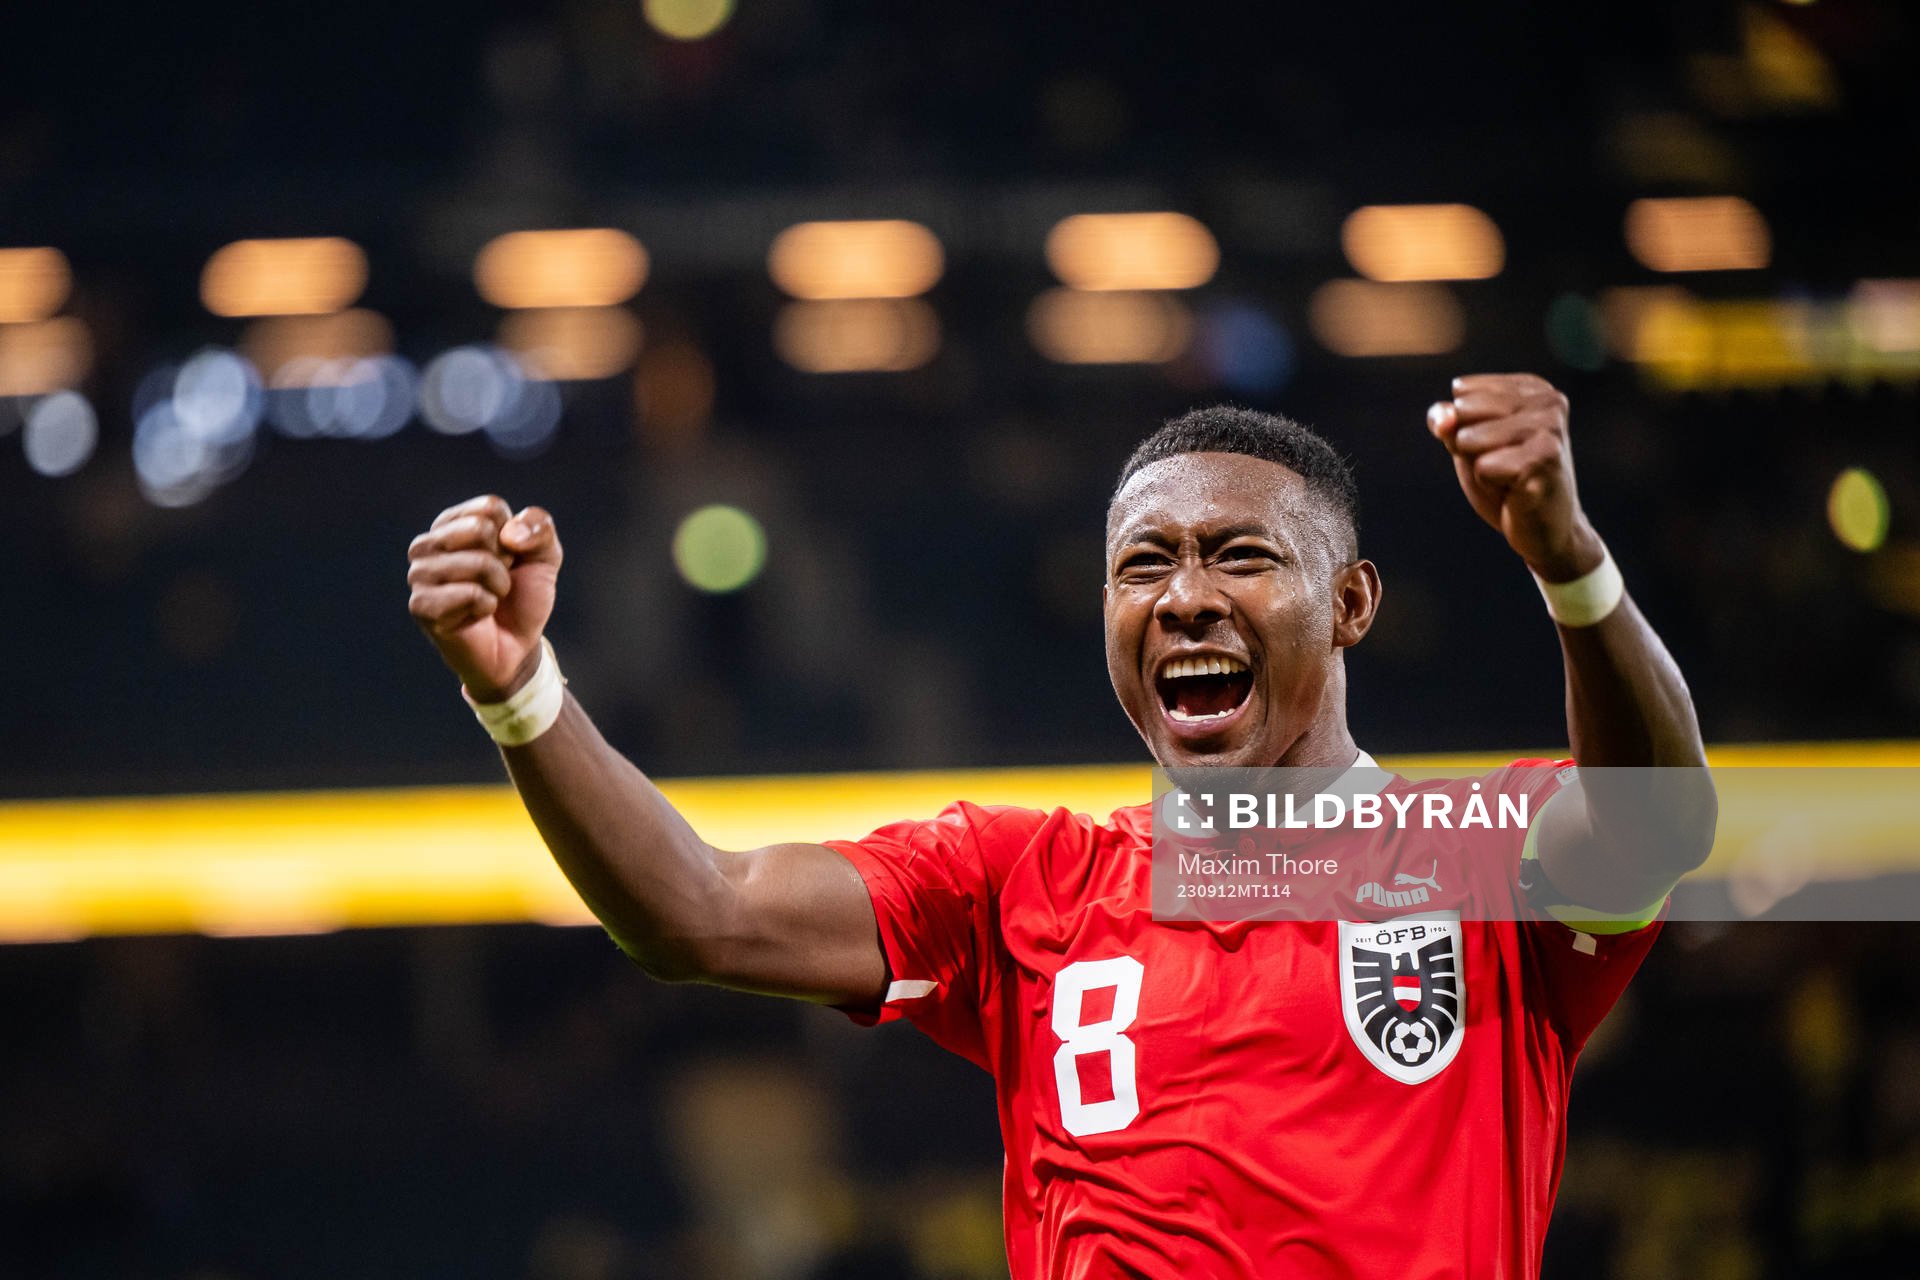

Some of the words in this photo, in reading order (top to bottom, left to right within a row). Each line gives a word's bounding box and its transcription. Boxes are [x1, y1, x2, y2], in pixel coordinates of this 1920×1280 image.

[1356, 881, 1430, 908] PUMA
[1375, 925, 1427, 946] ÖFB
[1430, 926, 1448, 934] 1904
[1051, 955, 1145, 1138] 8
